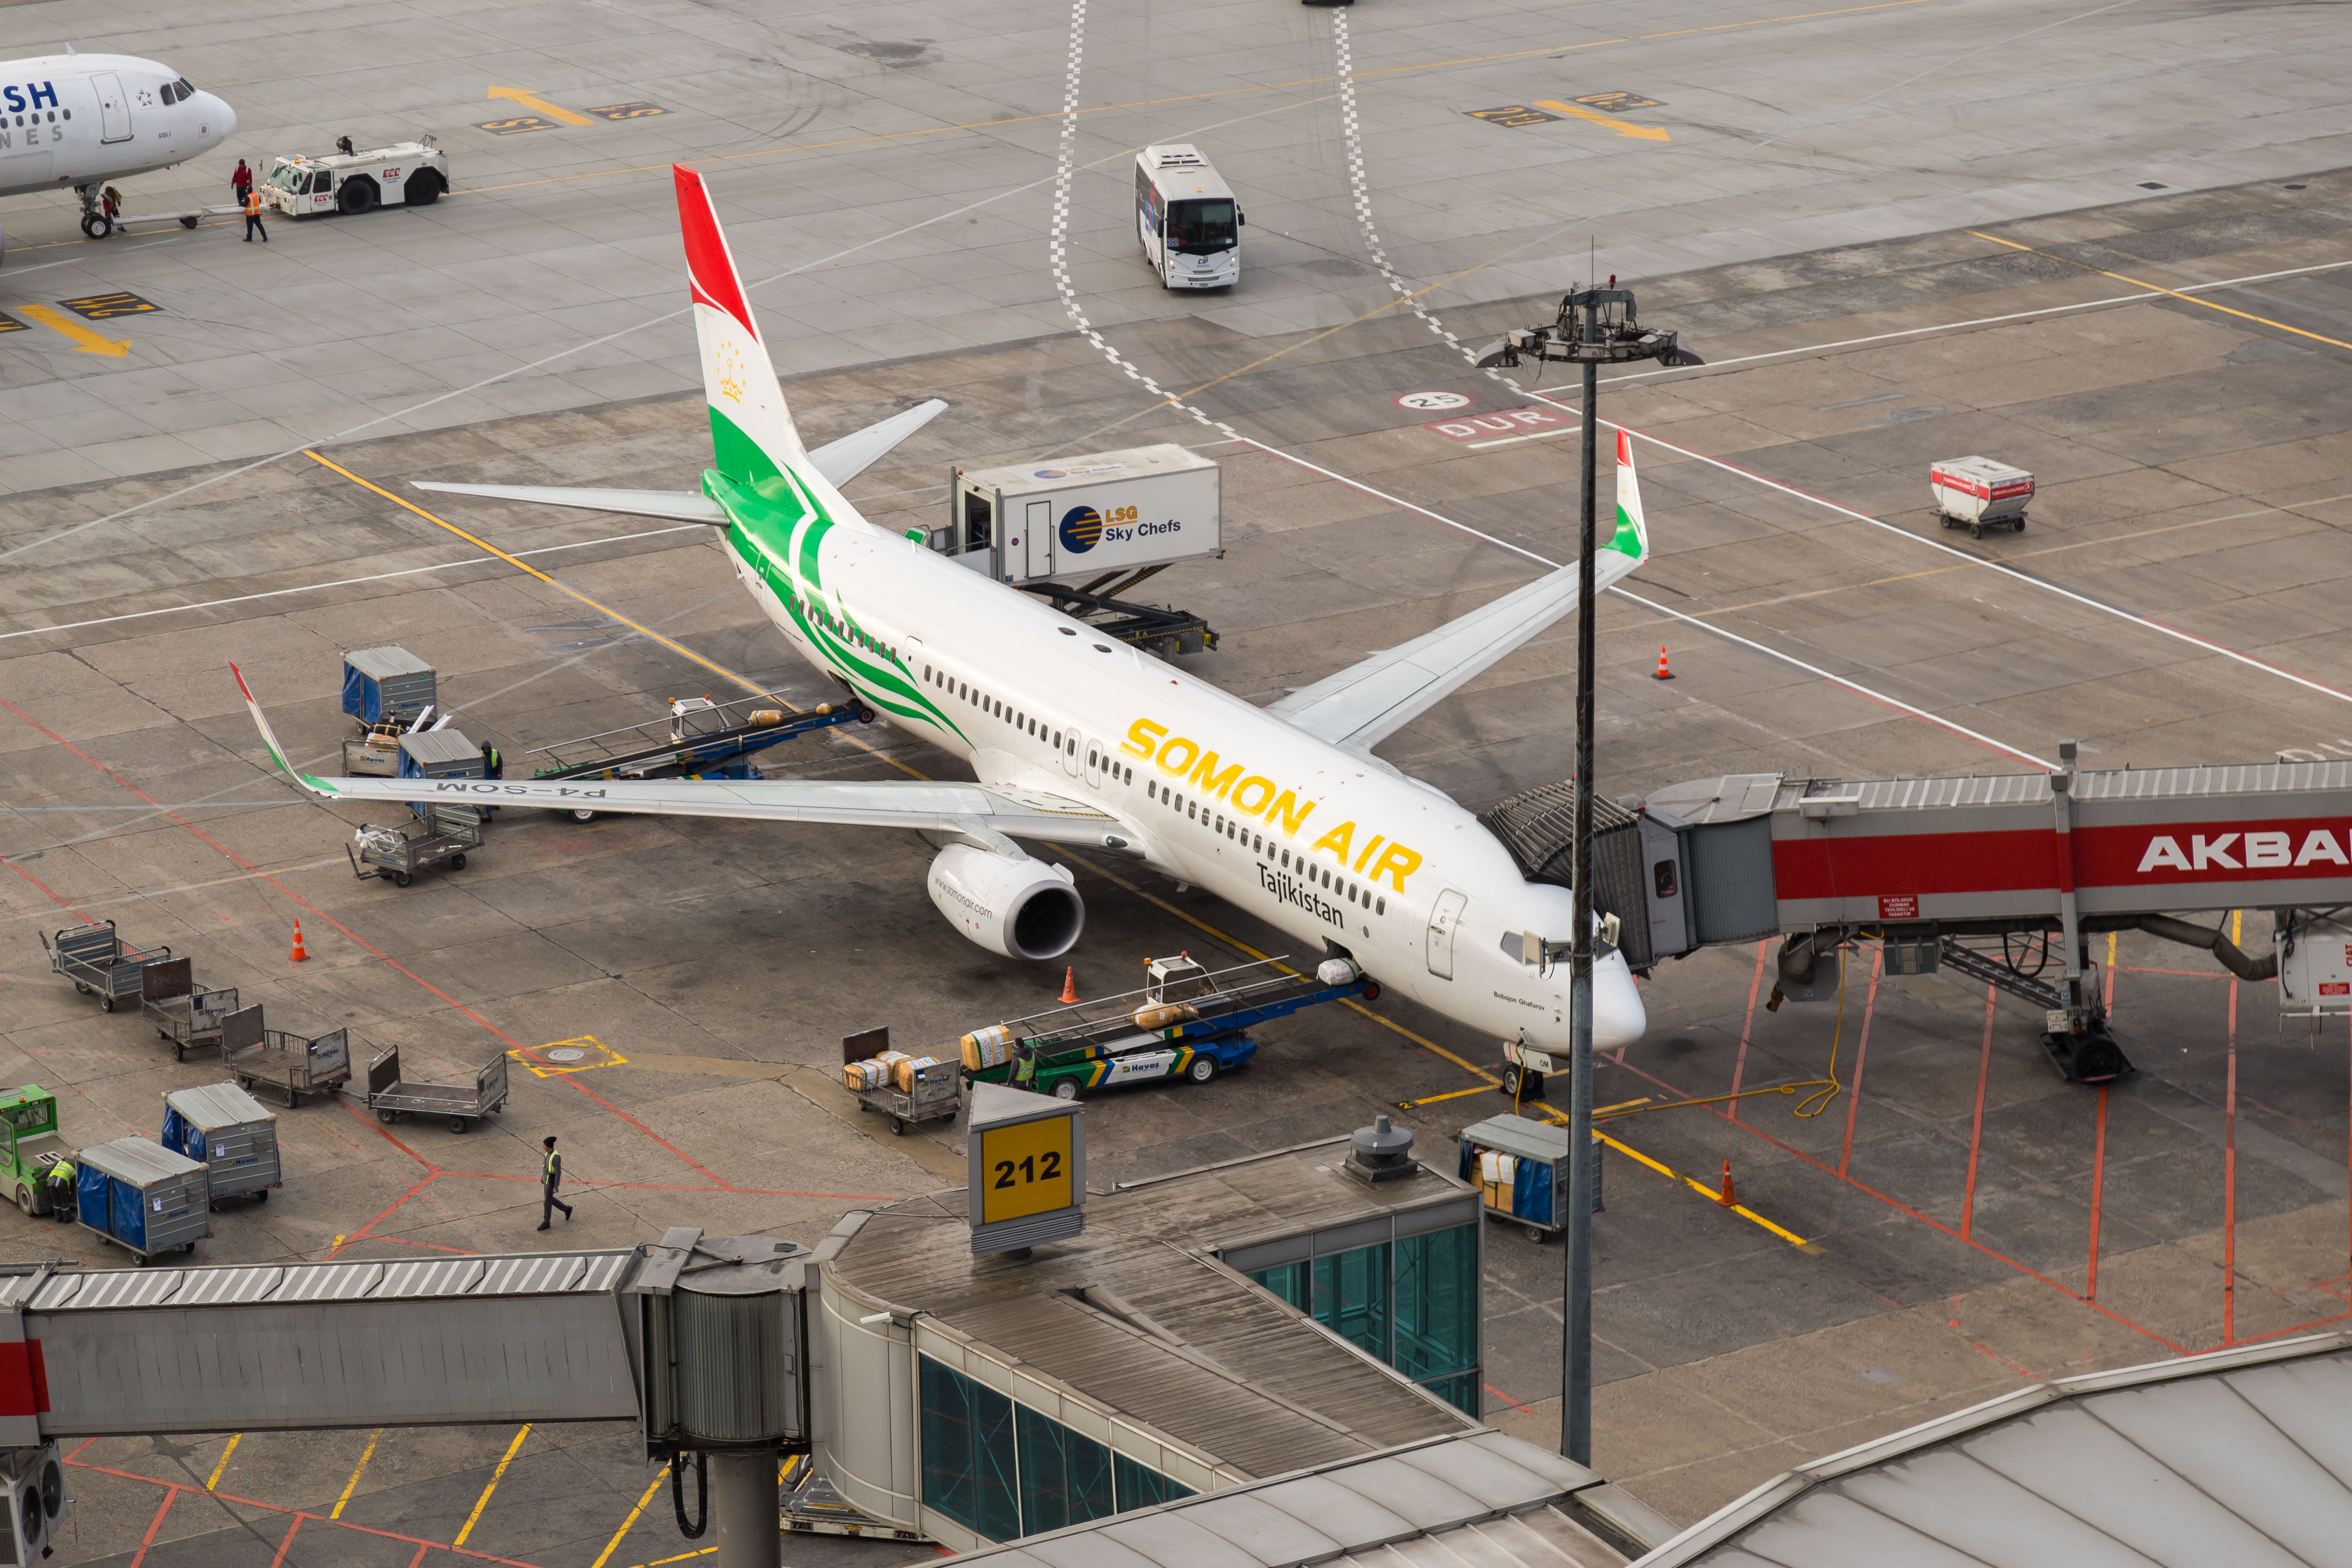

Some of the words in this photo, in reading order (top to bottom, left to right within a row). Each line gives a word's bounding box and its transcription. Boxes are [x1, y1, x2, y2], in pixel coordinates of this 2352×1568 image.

[0, 81, 58, 114] SH
[158, 130, 172, 140] ŞİŞLİ
[1167, 237, 1179, 247] 32
[1409, 394, 1461, 407] 25
[1436, 411, 1556, 437] DUR
[1106, 505, 1137, 523] LSG
[1106, 527, 1133, 541] Sky
[1138, 519, 1181, 536] Chefs
[437, 783, 606, 798] P4-SOM
[1118, 718, 1317, 840] SOMON
[1310, 821, 1423, 895] AIR
[2137, 829, 2352, 873] AKBA
[935, 876, 992, 919] www.somonair.com
[1256, 862, 1344, 930] Tajikistan
[1494, 991, 1517, 1003] Bobojon
[1519, 998, 1545, 1011] Ghafurov
[1132, 1062, 1160, 1072] Havaş
[1540, 1059, 1550, 1068] OM
[994, 1151, 1061, 1190] 212
